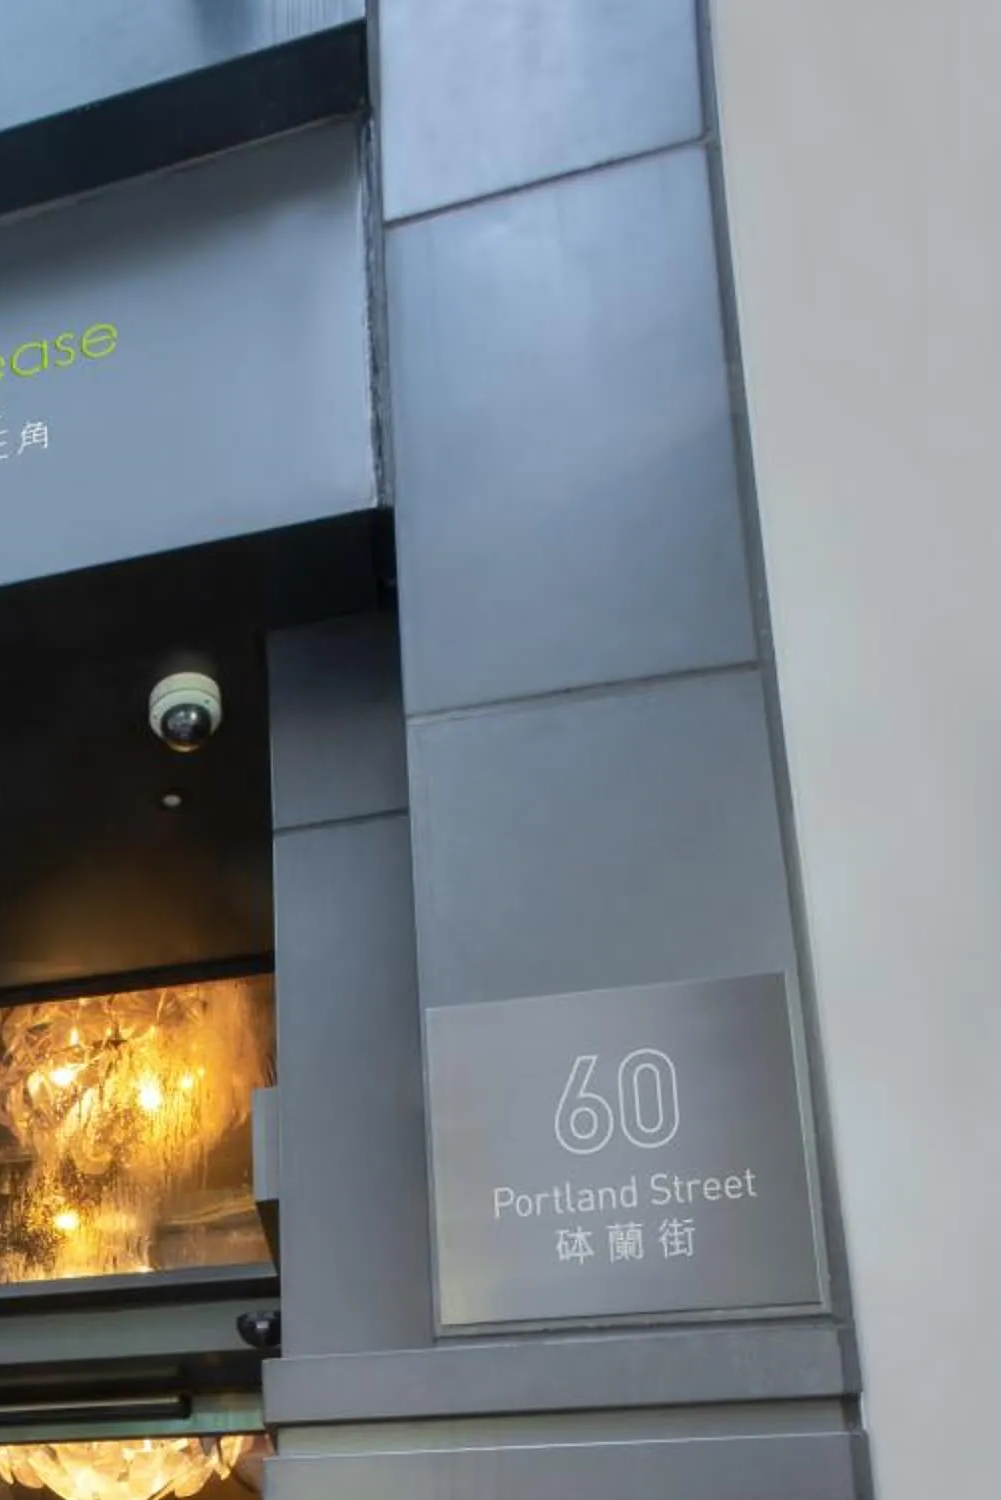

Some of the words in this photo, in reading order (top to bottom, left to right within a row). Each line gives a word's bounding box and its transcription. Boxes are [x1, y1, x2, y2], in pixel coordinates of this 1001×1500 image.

[554, 1047, 680, 1155] 60
[493, 1176, 638, 1219] Portland
[650, 1167, 759, 1206] Street
[554, 1217, 696, 1266] 砵蘭街
